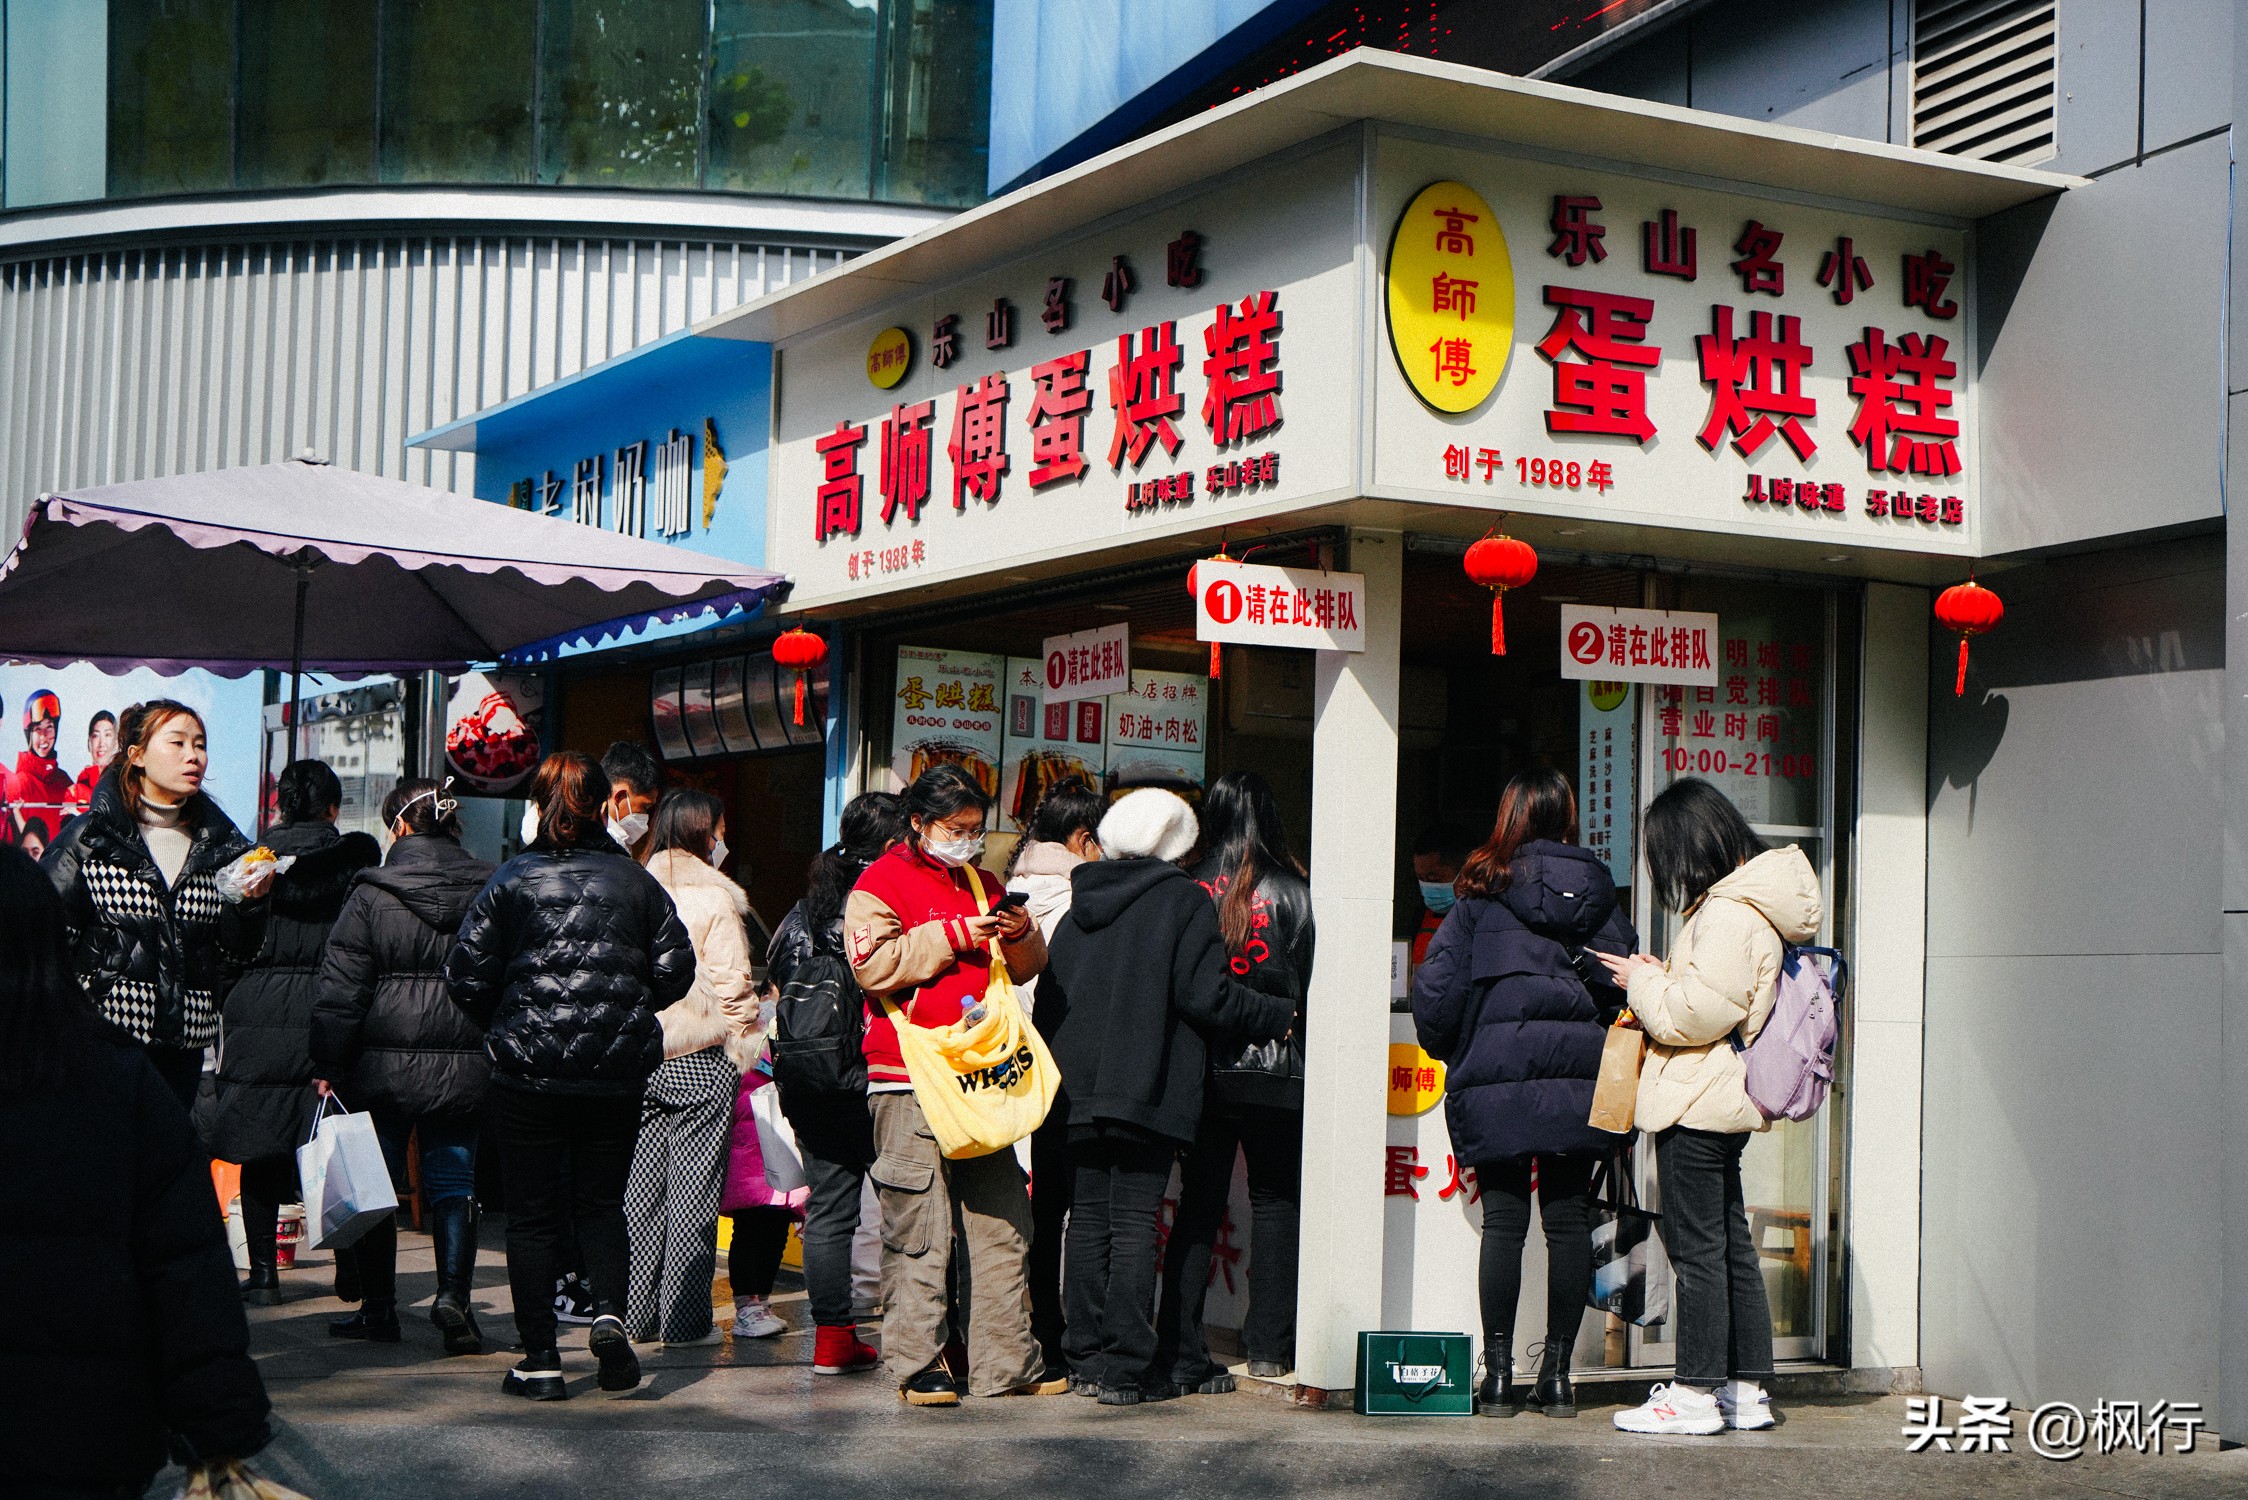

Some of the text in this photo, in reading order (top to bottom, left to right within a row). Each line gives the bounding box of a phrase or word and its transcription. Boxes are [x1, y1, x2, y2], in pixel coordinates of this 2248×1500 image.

[1549, 195, 1958, 320] 乐山名小吃
[932, 231, 1205, 369] 乐山名小吃
[1430, 207, 1478, 386] 高師傅
[1535, 285, 1963, 478] 蛋烘糕
[815, 290, 1286, 542] 高师傅蛋烘糕
[1124, 452, 1280, 511] 儿时味道 乐山老店
[1744, 474, 1964, 525] 儿时味道 乐山老店
[1246, 583, 1359, 632] 请在此排队
[1067, 638, 1125, 686] 请在此排队
[1608, 622, 1712, 670] 请在此排队
[897, 676, 1001, 714] 蛋烘糕
[1119, 713, 1198, 743] 奶油+肉松
